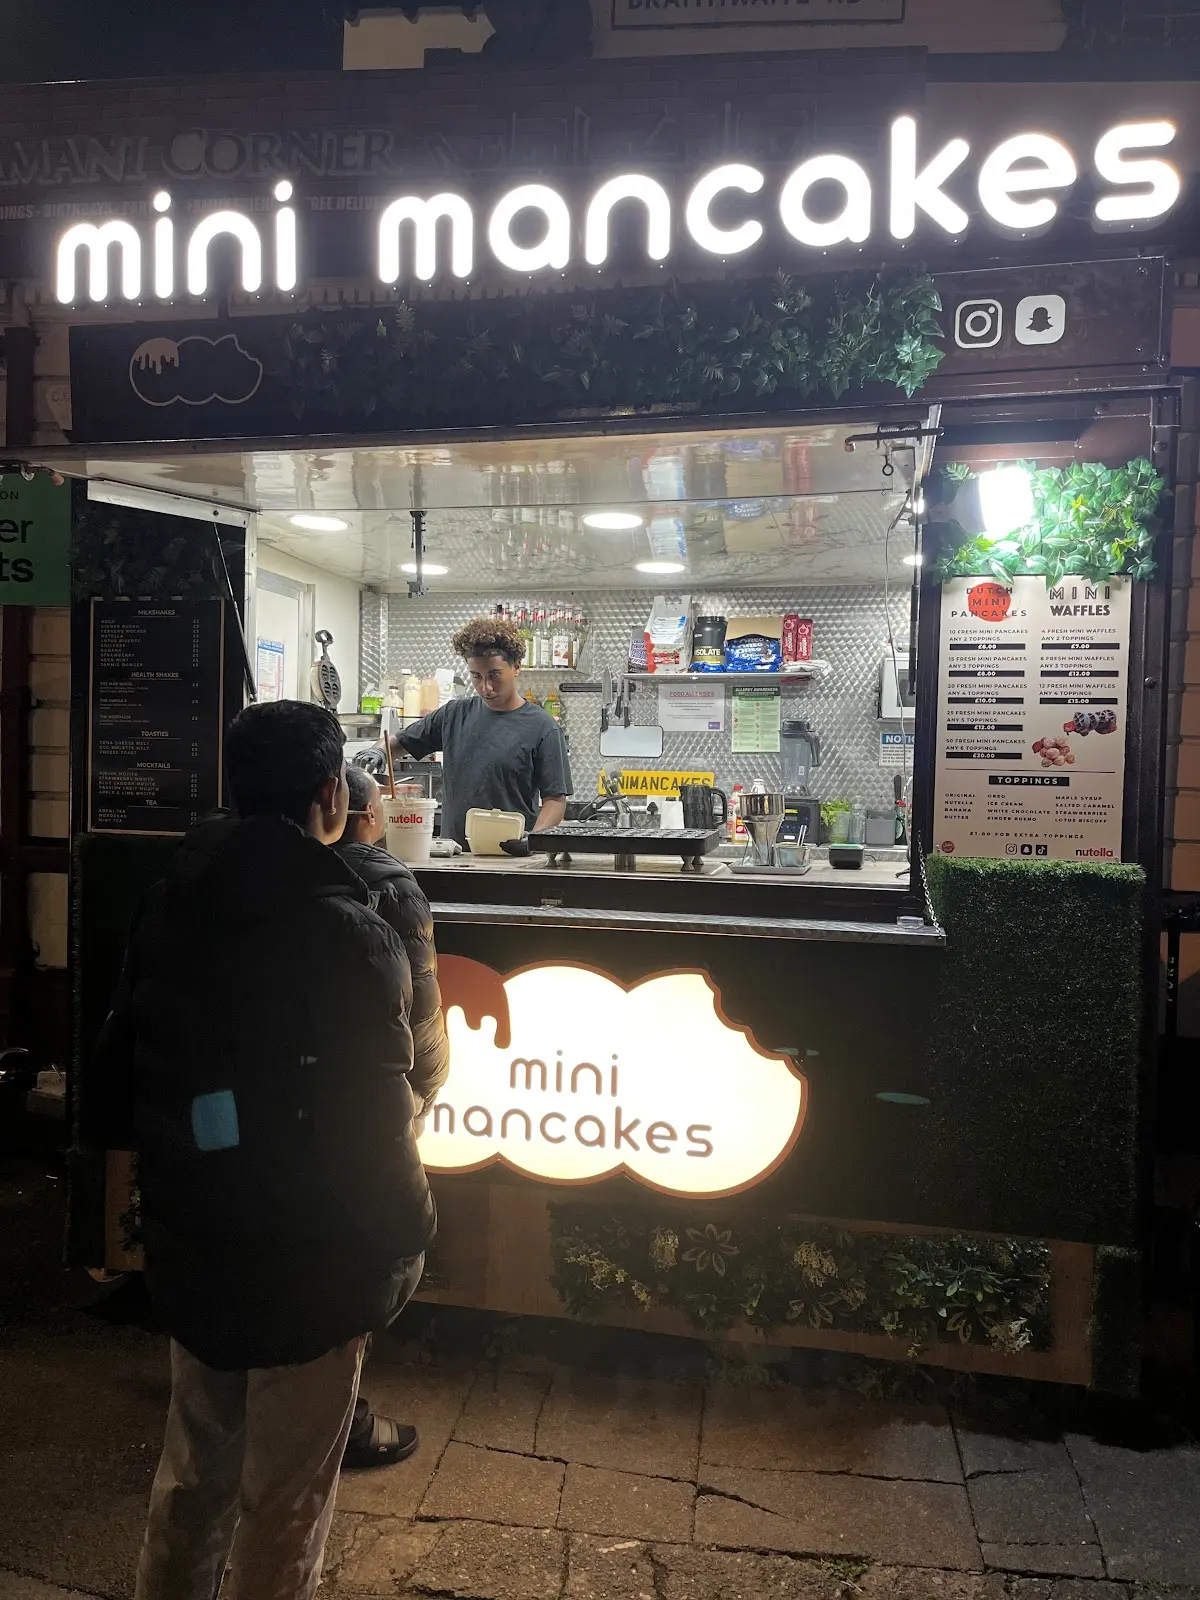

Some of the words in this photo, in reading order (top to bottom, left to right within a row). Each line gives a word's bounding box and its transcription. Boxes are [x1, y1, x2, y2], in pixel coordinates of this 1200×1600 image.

[163, 127, 397, 182] CORNER
[56, 179, 297, 304] mini
[378, 115, 1181, 285] mancakes
[1050, 586, 1111, 600] MINI
[1050, 604, 1111, 616] WAFFLES
[389, 814, 423, 824] nutella
[1076, 848, 1113, 857] nutella
[510, 1049, 619, 1098] mini
